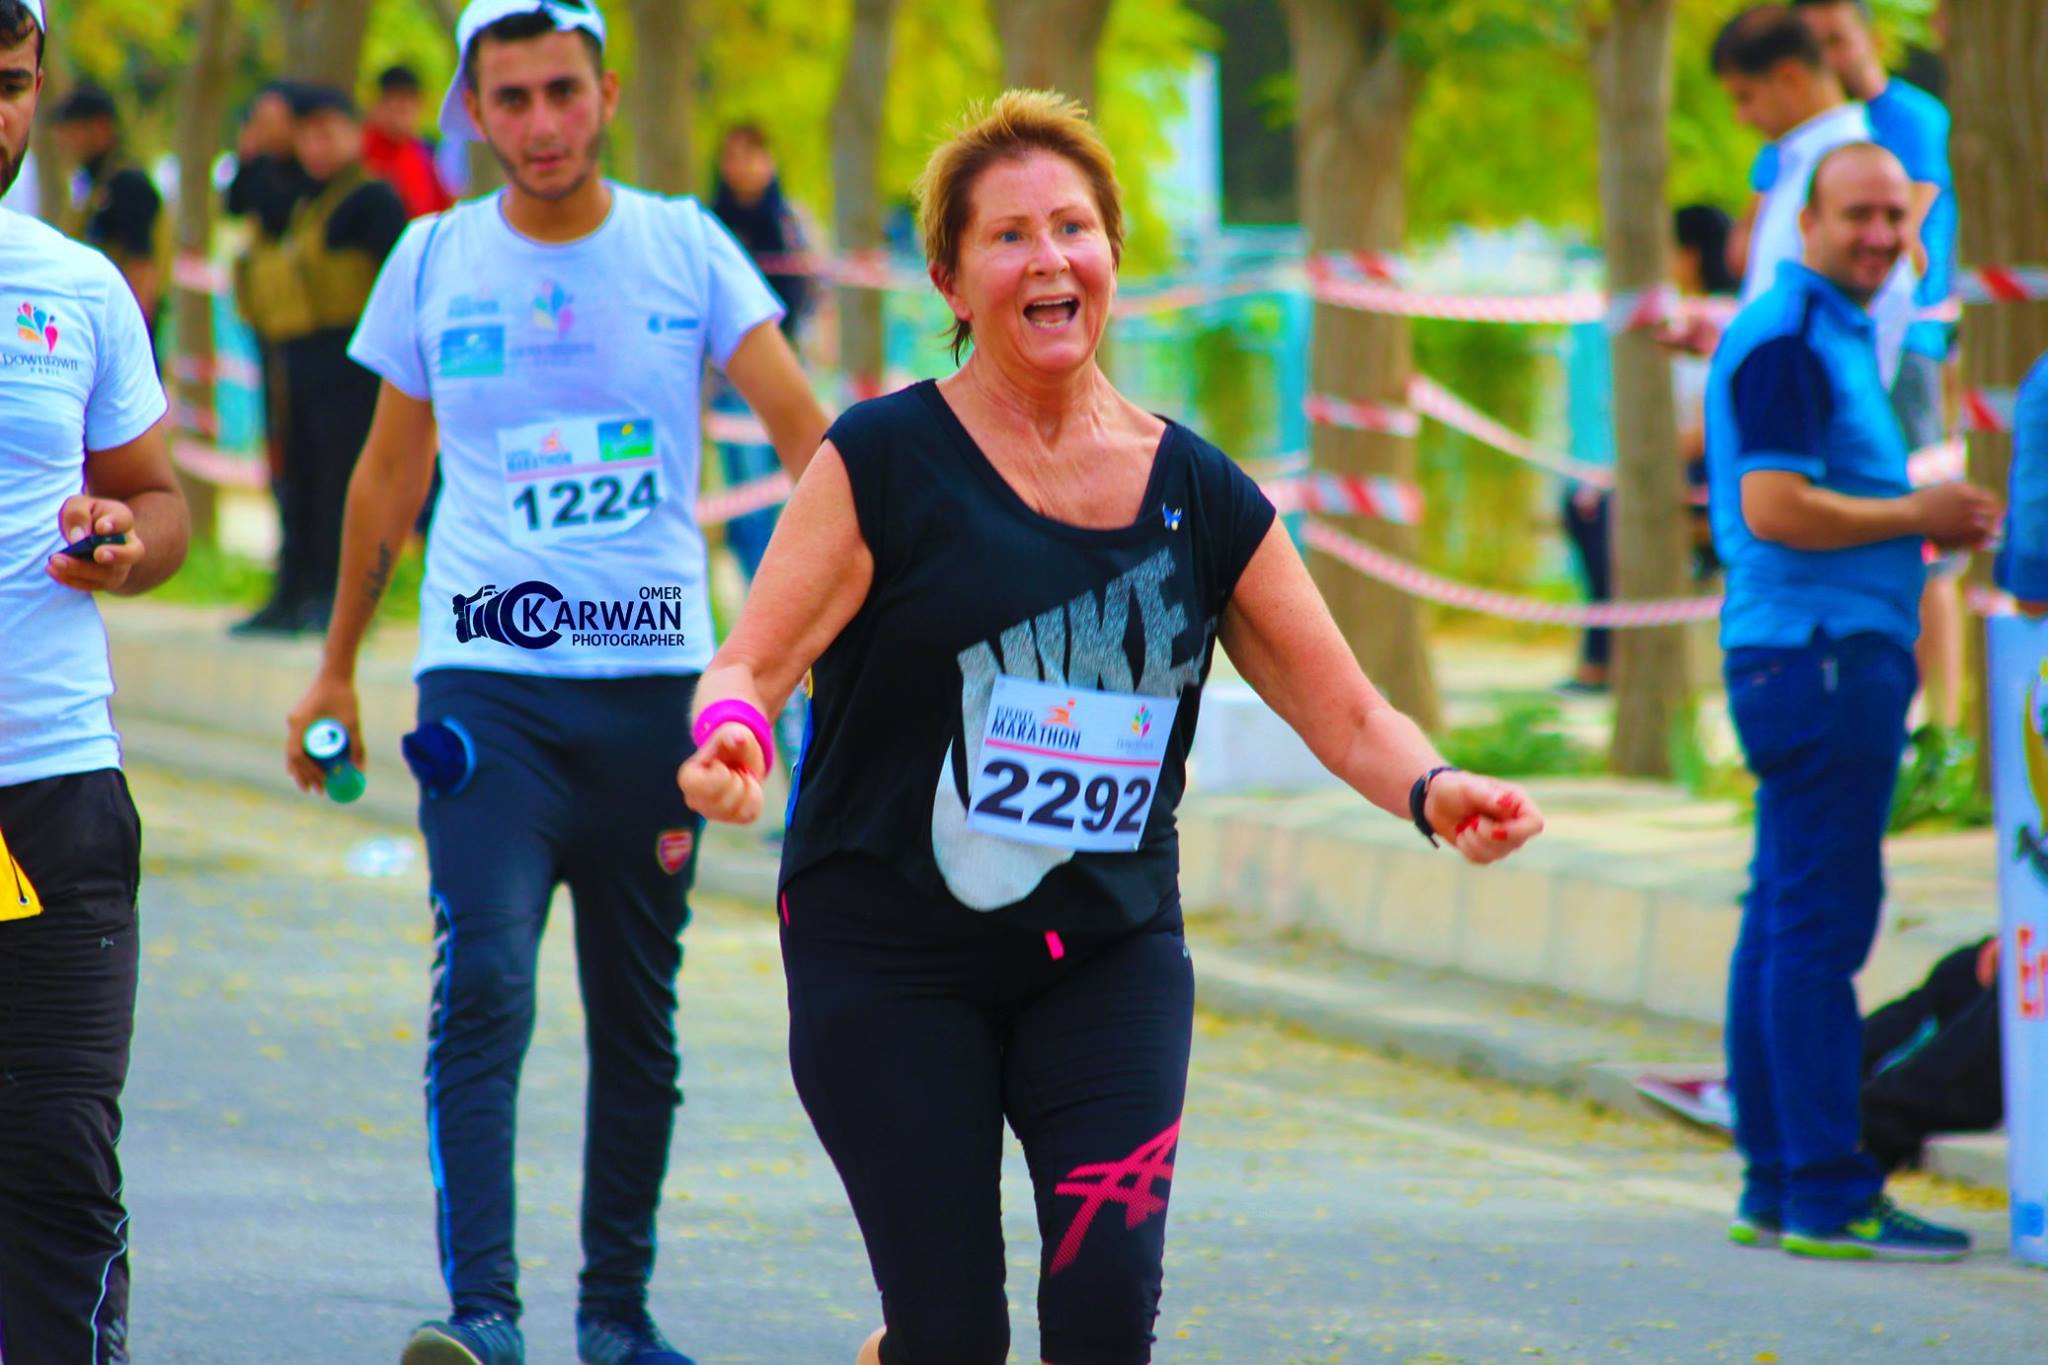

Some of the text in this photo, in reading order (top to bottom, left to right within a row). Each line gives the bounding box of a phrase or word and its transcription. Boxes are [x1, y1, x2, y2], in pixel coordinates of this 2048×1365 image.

[513, 470, 664, 532] 1224
[991, 718, 1082, 751] MARATHON
[973, 759, 1152, 834] 2292
